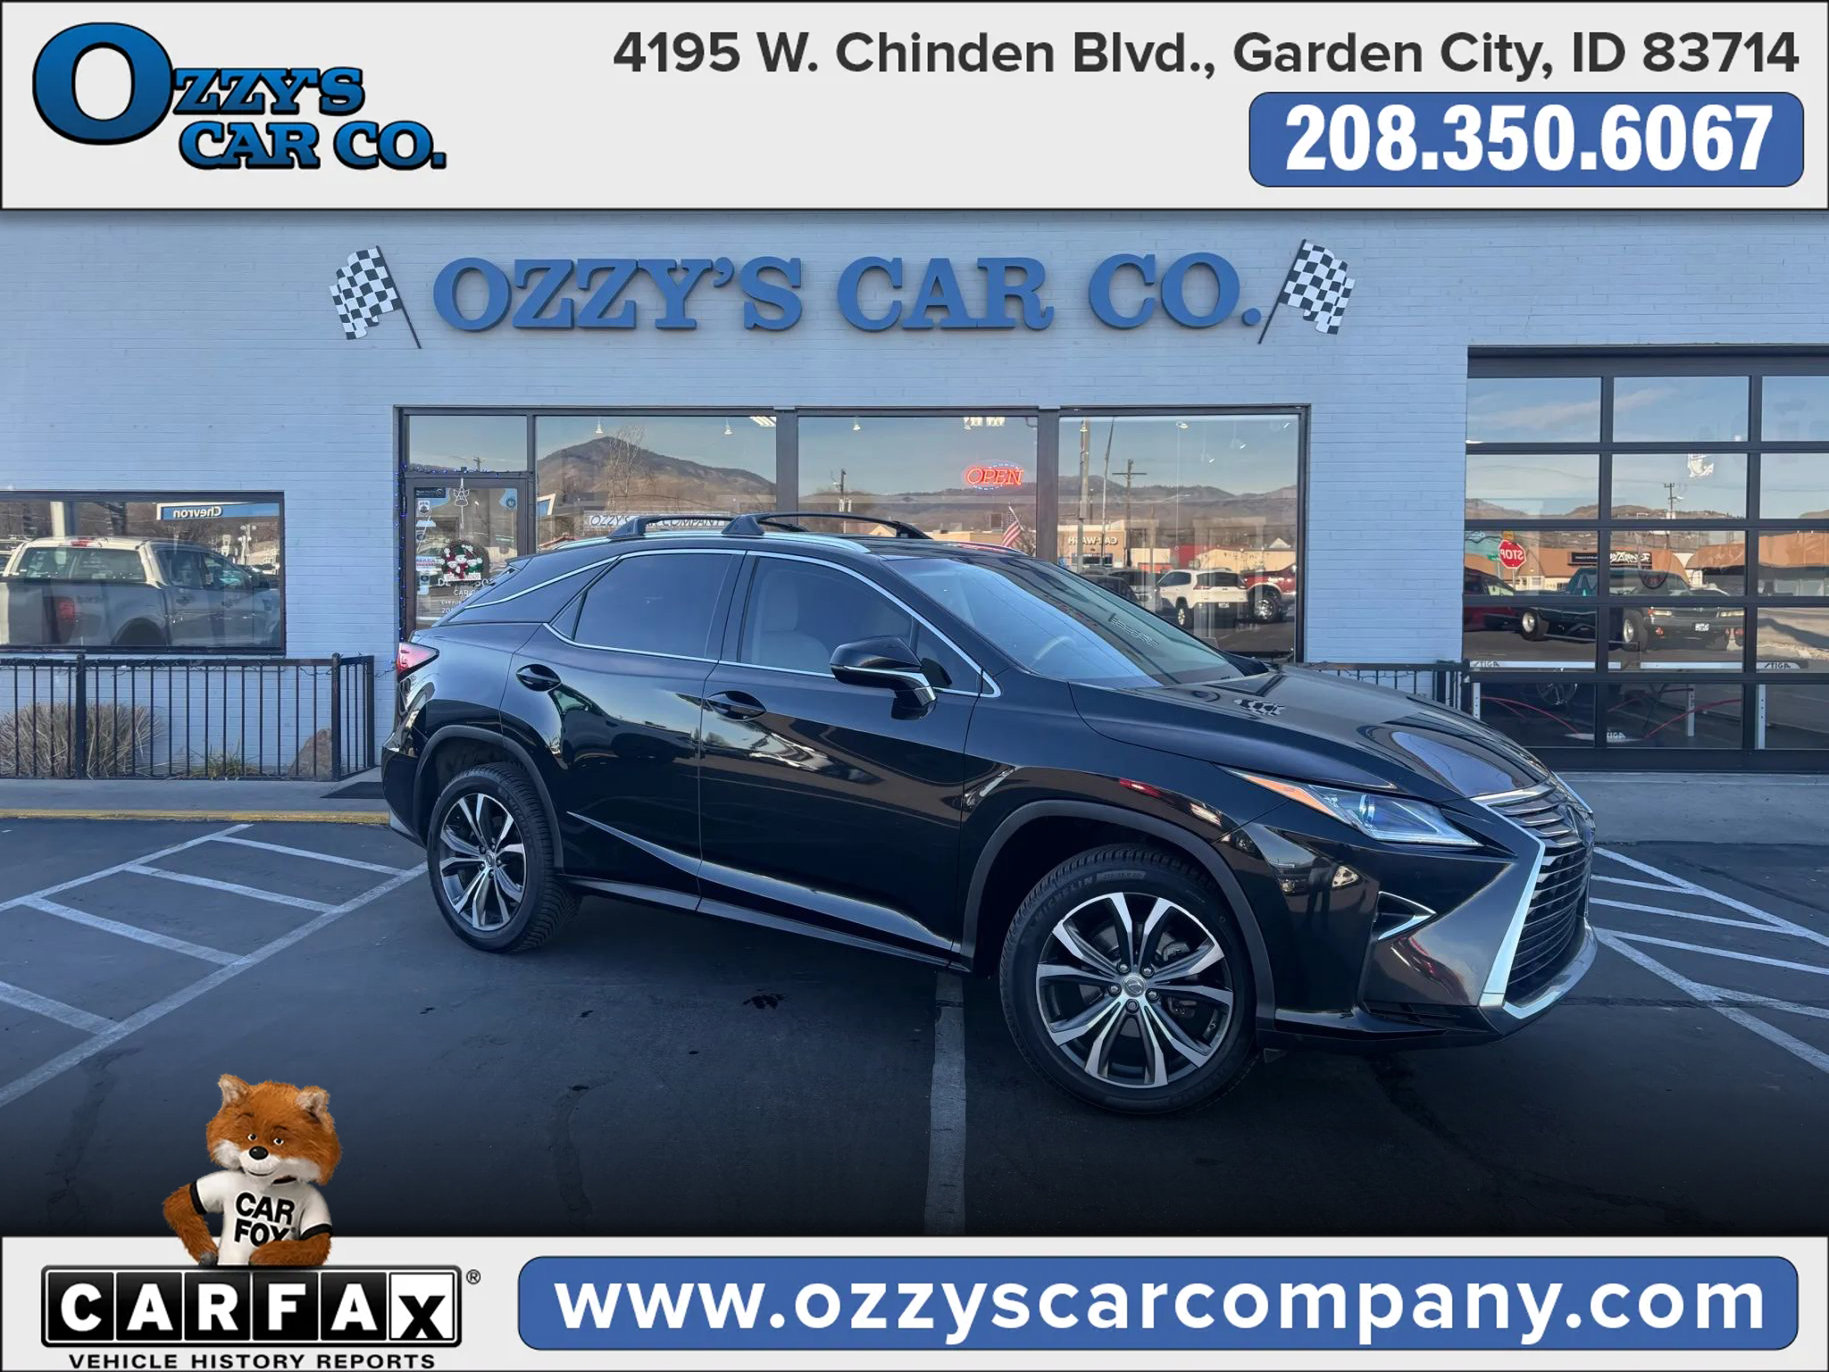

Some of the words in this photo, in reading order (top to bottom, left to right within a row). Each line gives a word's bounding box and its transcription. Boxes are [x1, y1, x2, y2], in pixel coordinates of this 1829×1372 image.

[433, 256, 803, 332] OZZY’S
[837, 256, 1055, 332] CAR
[1088, 252, 1262, 331] CO.
[964, 466, 1024, 487] OPEN
